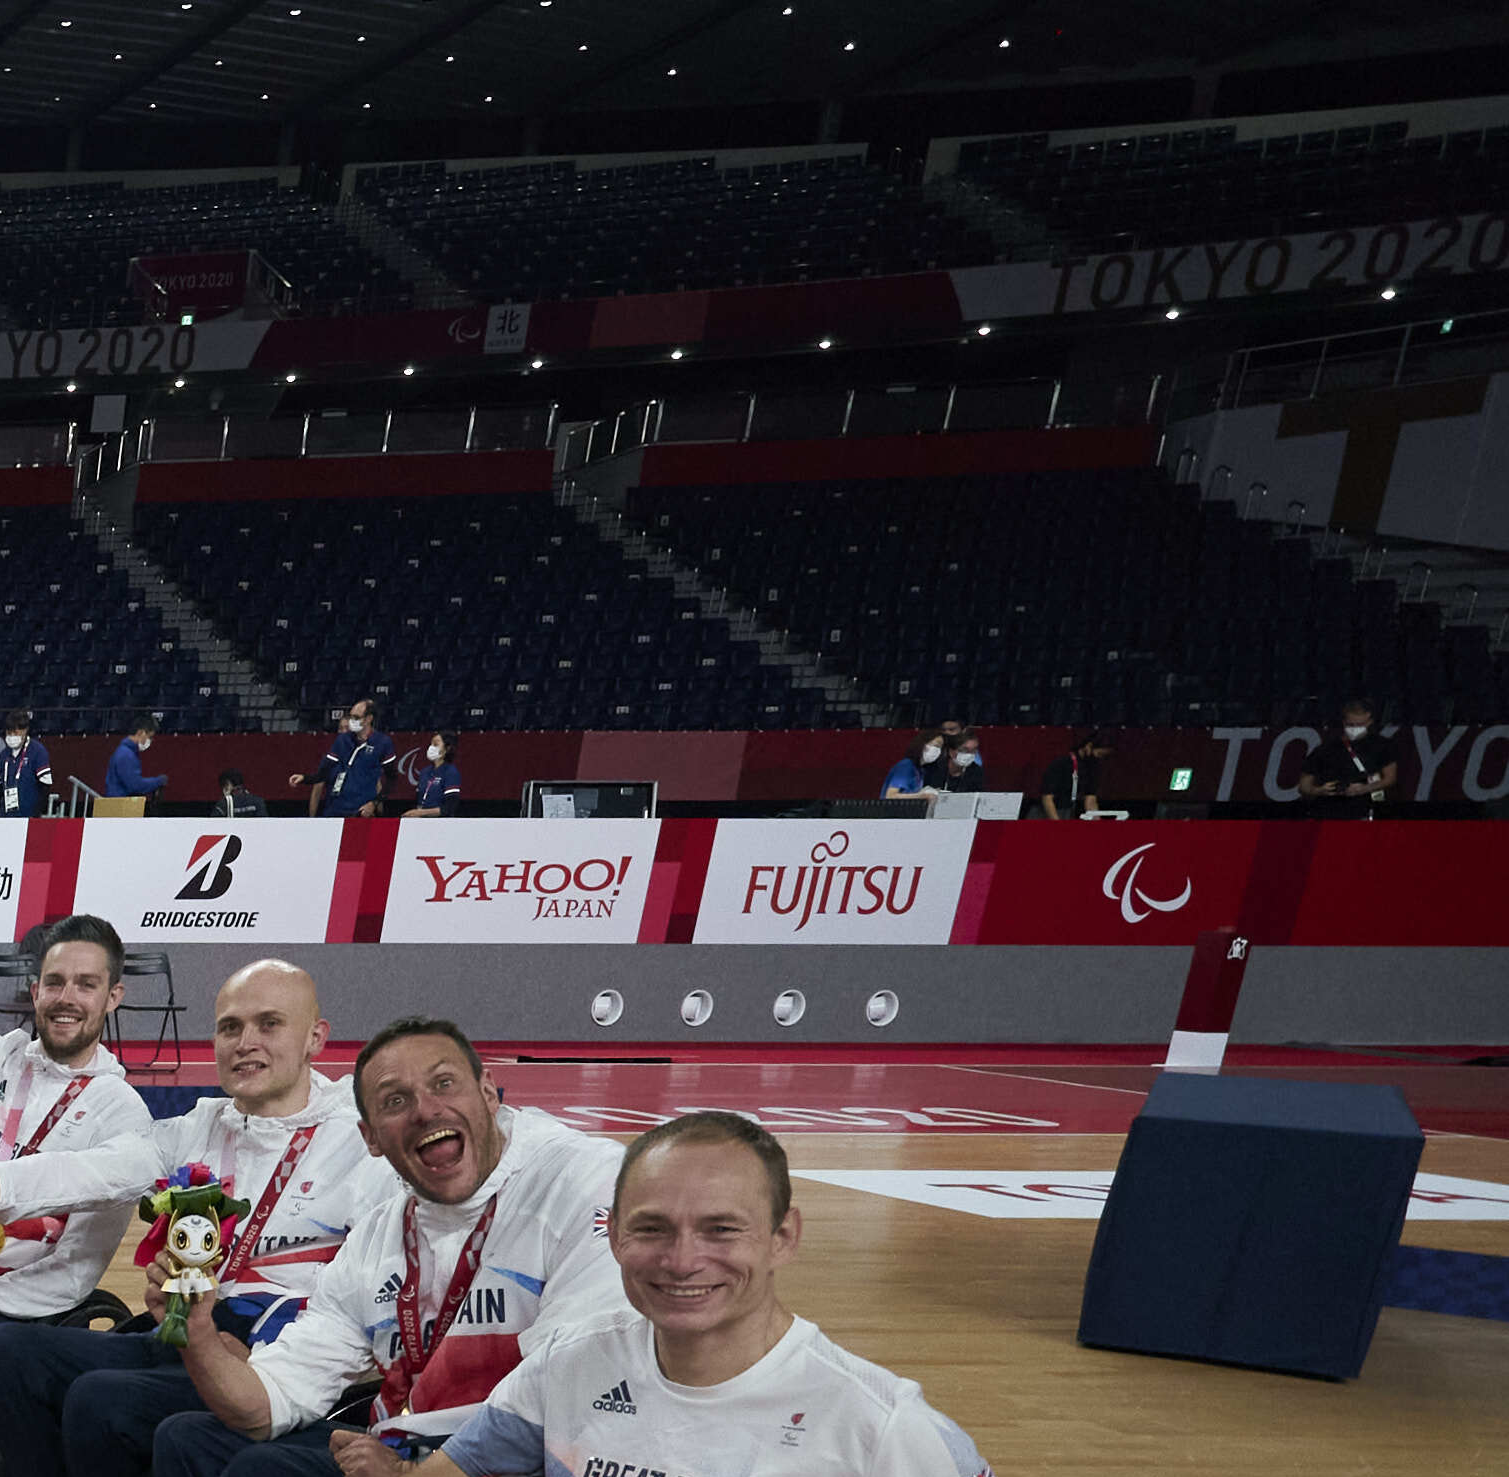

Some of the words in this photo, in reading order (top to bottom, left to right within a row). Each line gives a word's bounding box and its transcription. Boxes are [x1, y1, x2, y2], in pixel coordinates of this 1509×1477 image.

[1052, 237, 1291, 320] TOKYO
[75, 326, 195, 377] 2020
[1212, 724, 1509, 802] TOYO
[416, 855, 632, 903] YAHOO!
[742, 865, 924, 932] FUJITSU
[141, 911, 259, 928] BRIDGESTONE
[533, 896, 615, 921] JAPAN
[229, 1246, 249, 1272] TOKYO
[246, 1224, 259, 1245] 2020
[592, 1400, 637, 1416] adidas
